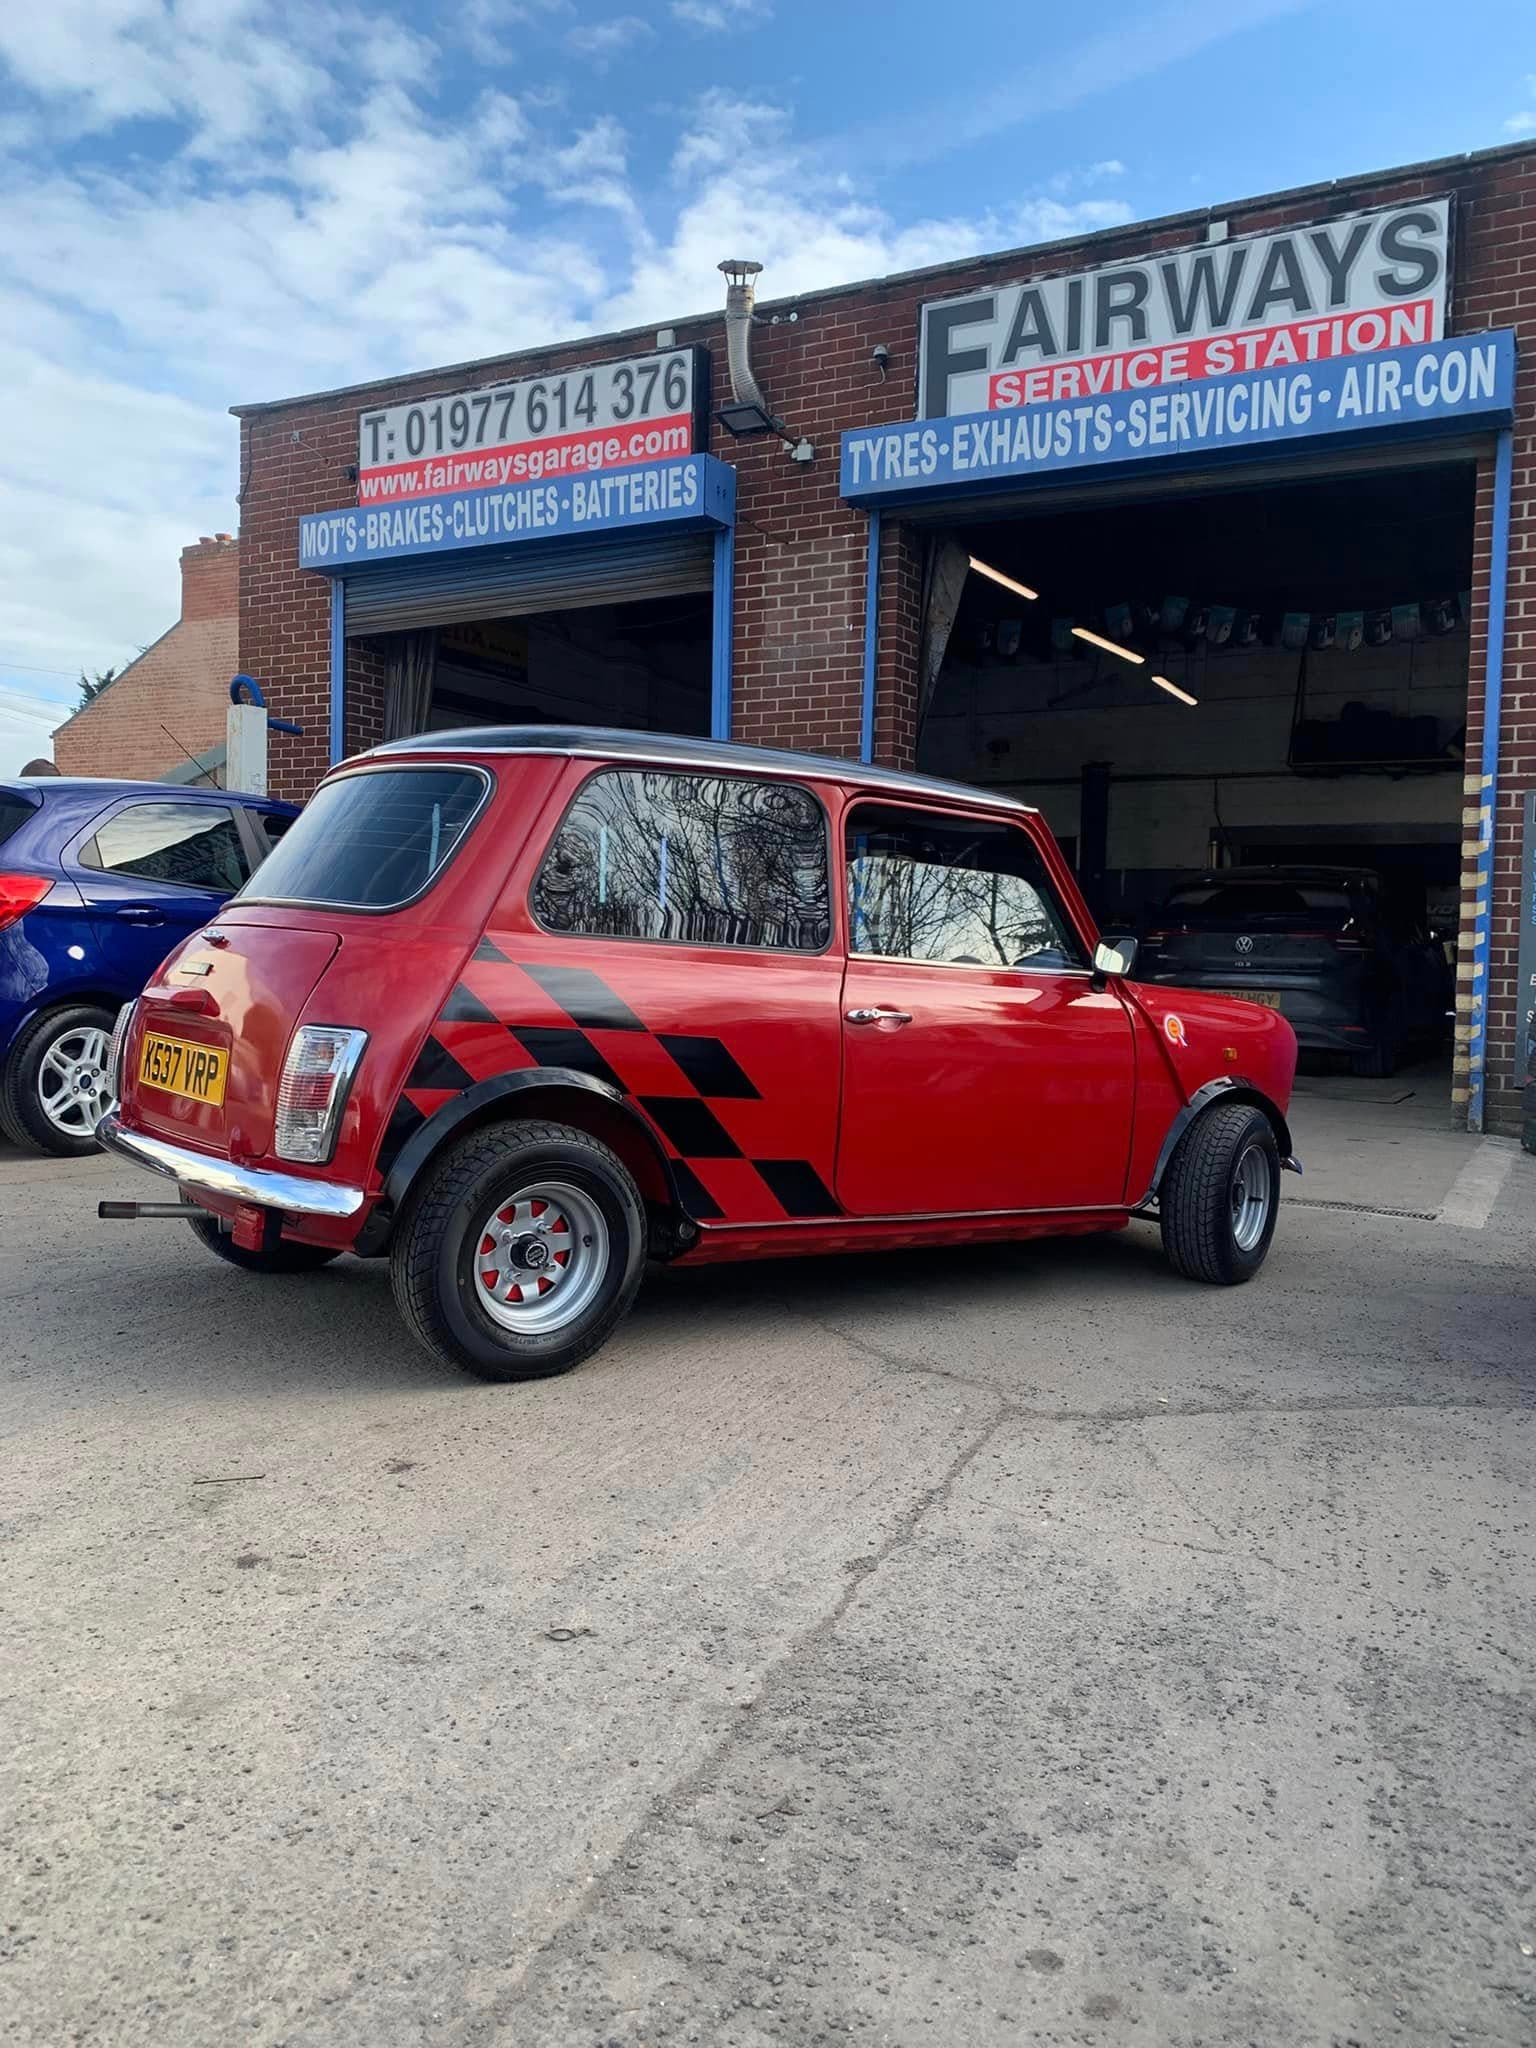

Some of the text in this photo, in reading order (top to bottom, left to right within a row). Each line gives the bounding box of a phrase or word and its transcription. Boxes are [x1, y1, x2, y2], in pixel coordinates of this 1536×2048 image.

[923, 211, 1442, 419] FAIRWAYS
[994, 305, 1426, 410] SERVICE STATION
[361, 426, 688, 498] www.fairwaysgarage.com
[364, 358, 687, 462] T: 01977 614 376
[849, 345, 1496, 484] TYRES EXHAUSTS SERVICING AIR-CON
[367, 504, 443, 550] BRAKES
[454, 486, 558, 538] CLUTCHES
[573, 464, 697, 522] BATTERIES
[143, 1039, 219, 1096] K537 VRP
